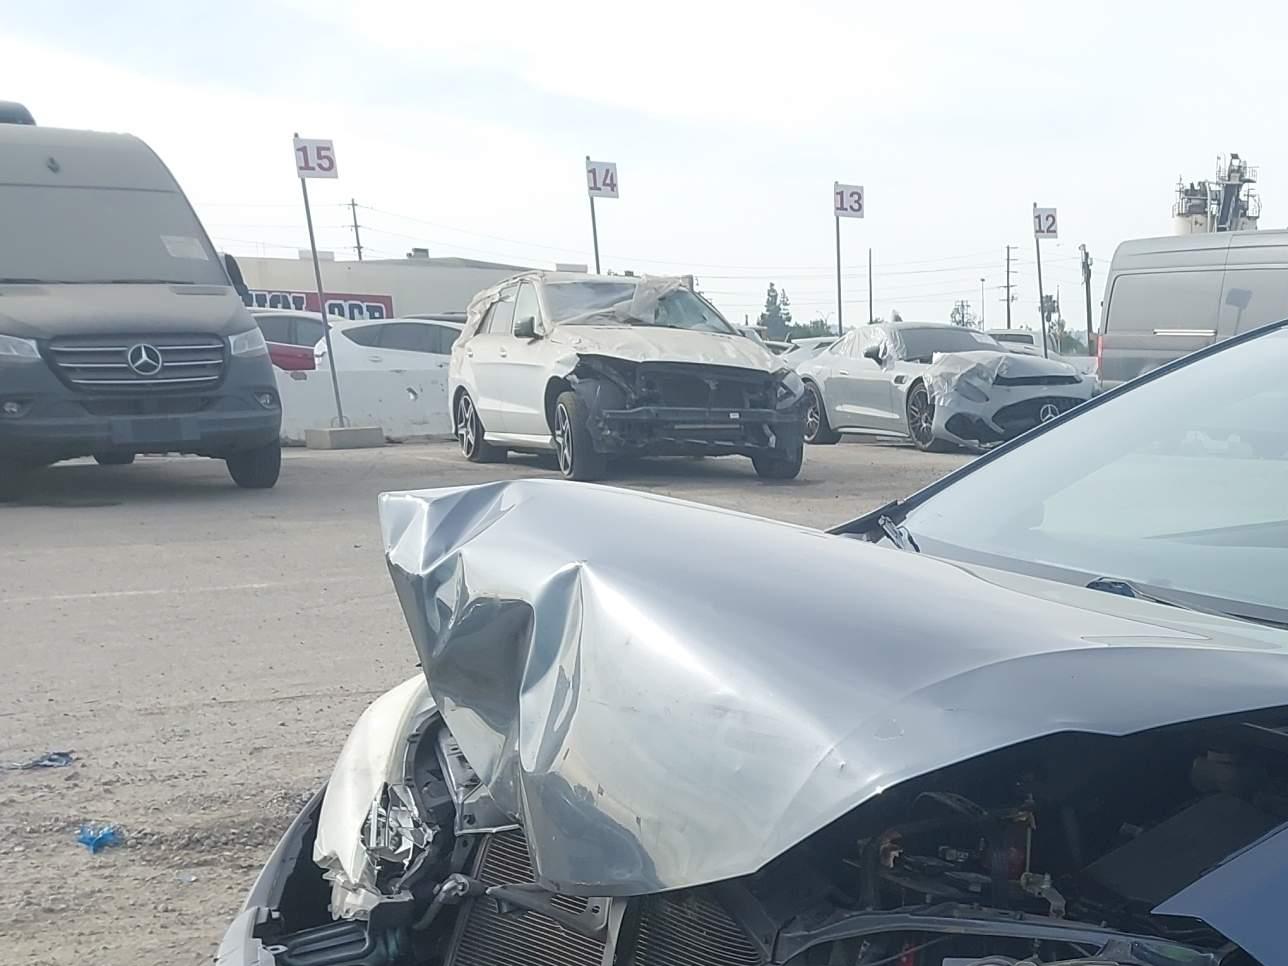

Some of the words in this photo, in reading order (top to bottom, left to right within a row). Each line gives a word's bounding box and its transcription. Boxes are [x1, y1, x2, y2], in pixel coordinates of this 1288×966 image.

[296, 145, 334, 171] 15
[588, 167, 617, 192] 14
[835, 190, 862, 212] 13
[1034, 213, 1056, 233] 12
